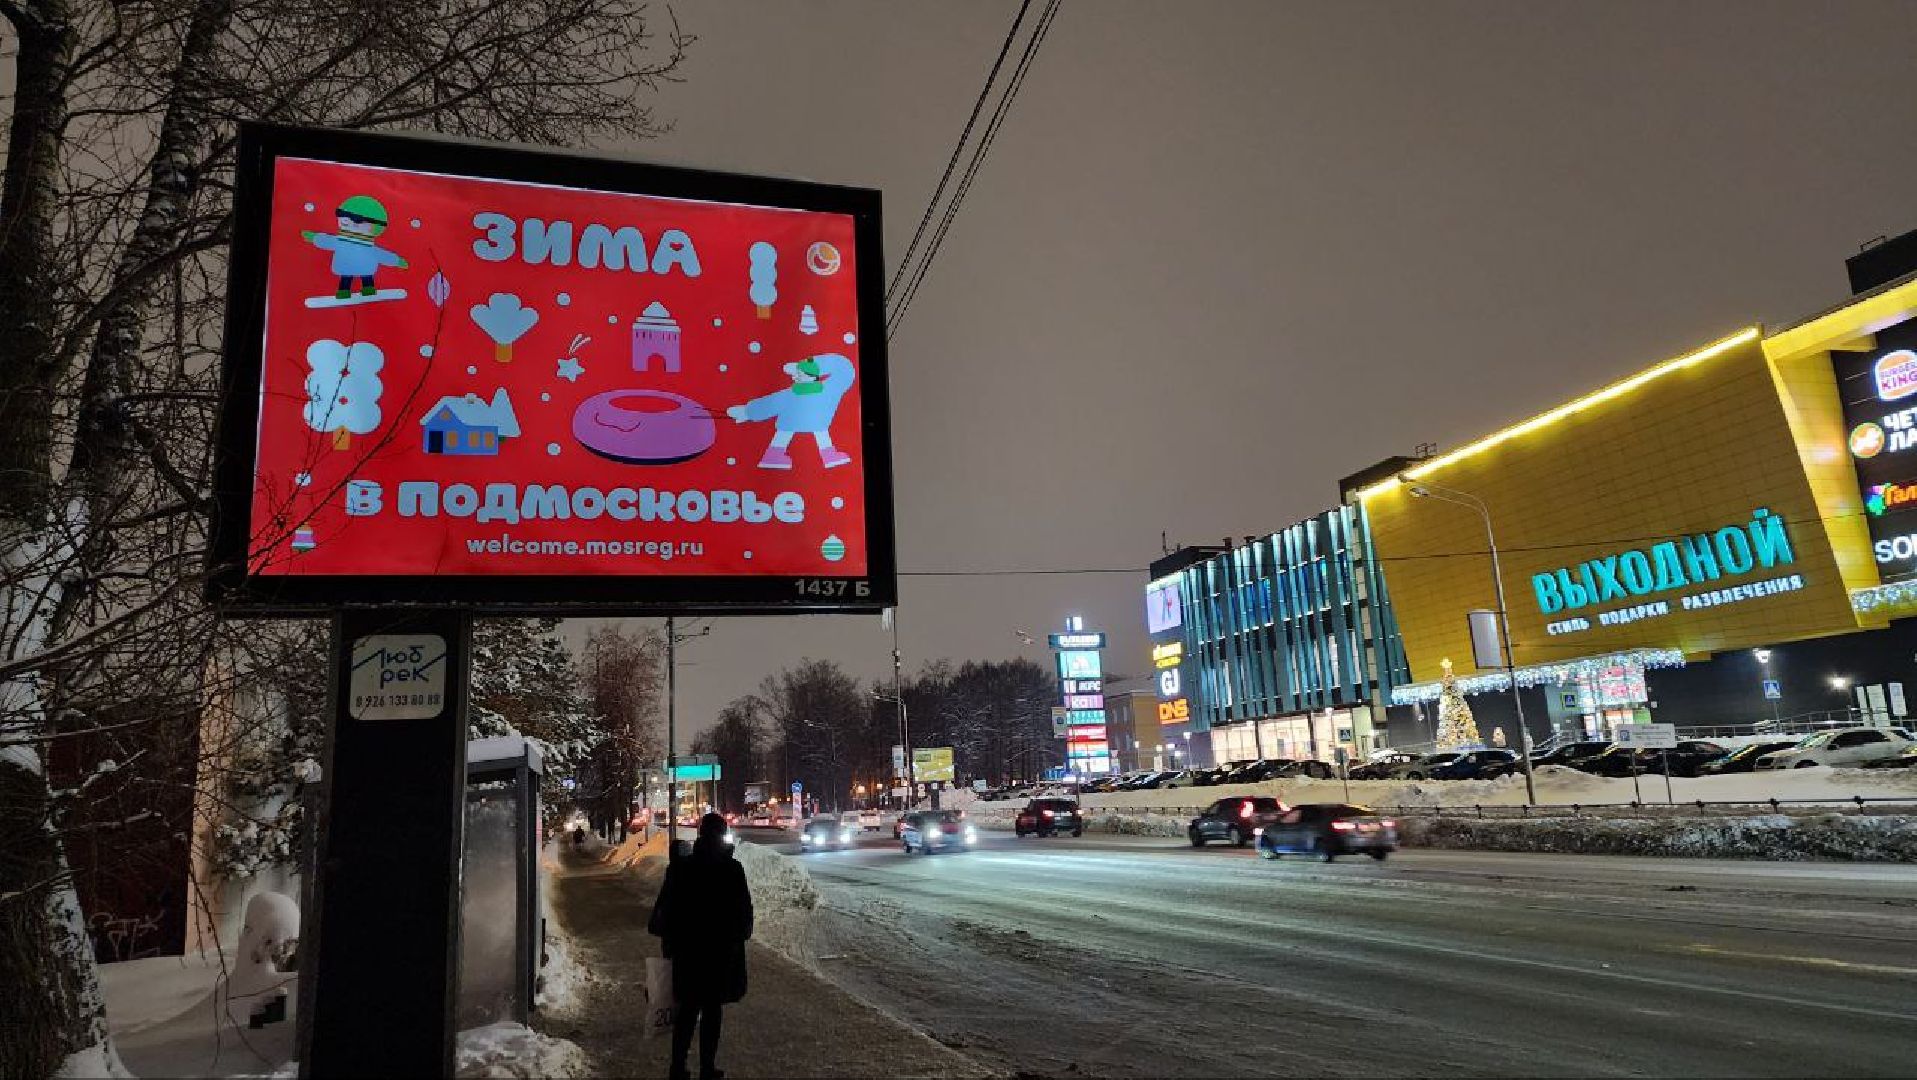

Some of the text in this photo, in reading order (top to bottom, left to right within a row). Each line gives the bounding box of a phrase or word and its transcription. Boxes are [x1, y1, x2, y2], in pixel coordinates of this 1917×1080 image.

[472, 211, 702, 278] ЗИМА
[466, 534, 704, 560] welcome.mosreg.ru
[1532, 508, 1794, 615] ВЫХОДНОЙ
[795, 578, 848, 597] 1437
[1547, 574, 1804, 636] СТИЛЬ ПОДАРКИ РАЗВЛЕЧЕНИЯ
[365, 696, 385, 708] 926
[388, 695, 408, 706] 133
[1159, 699, 1188, 721] DNS
